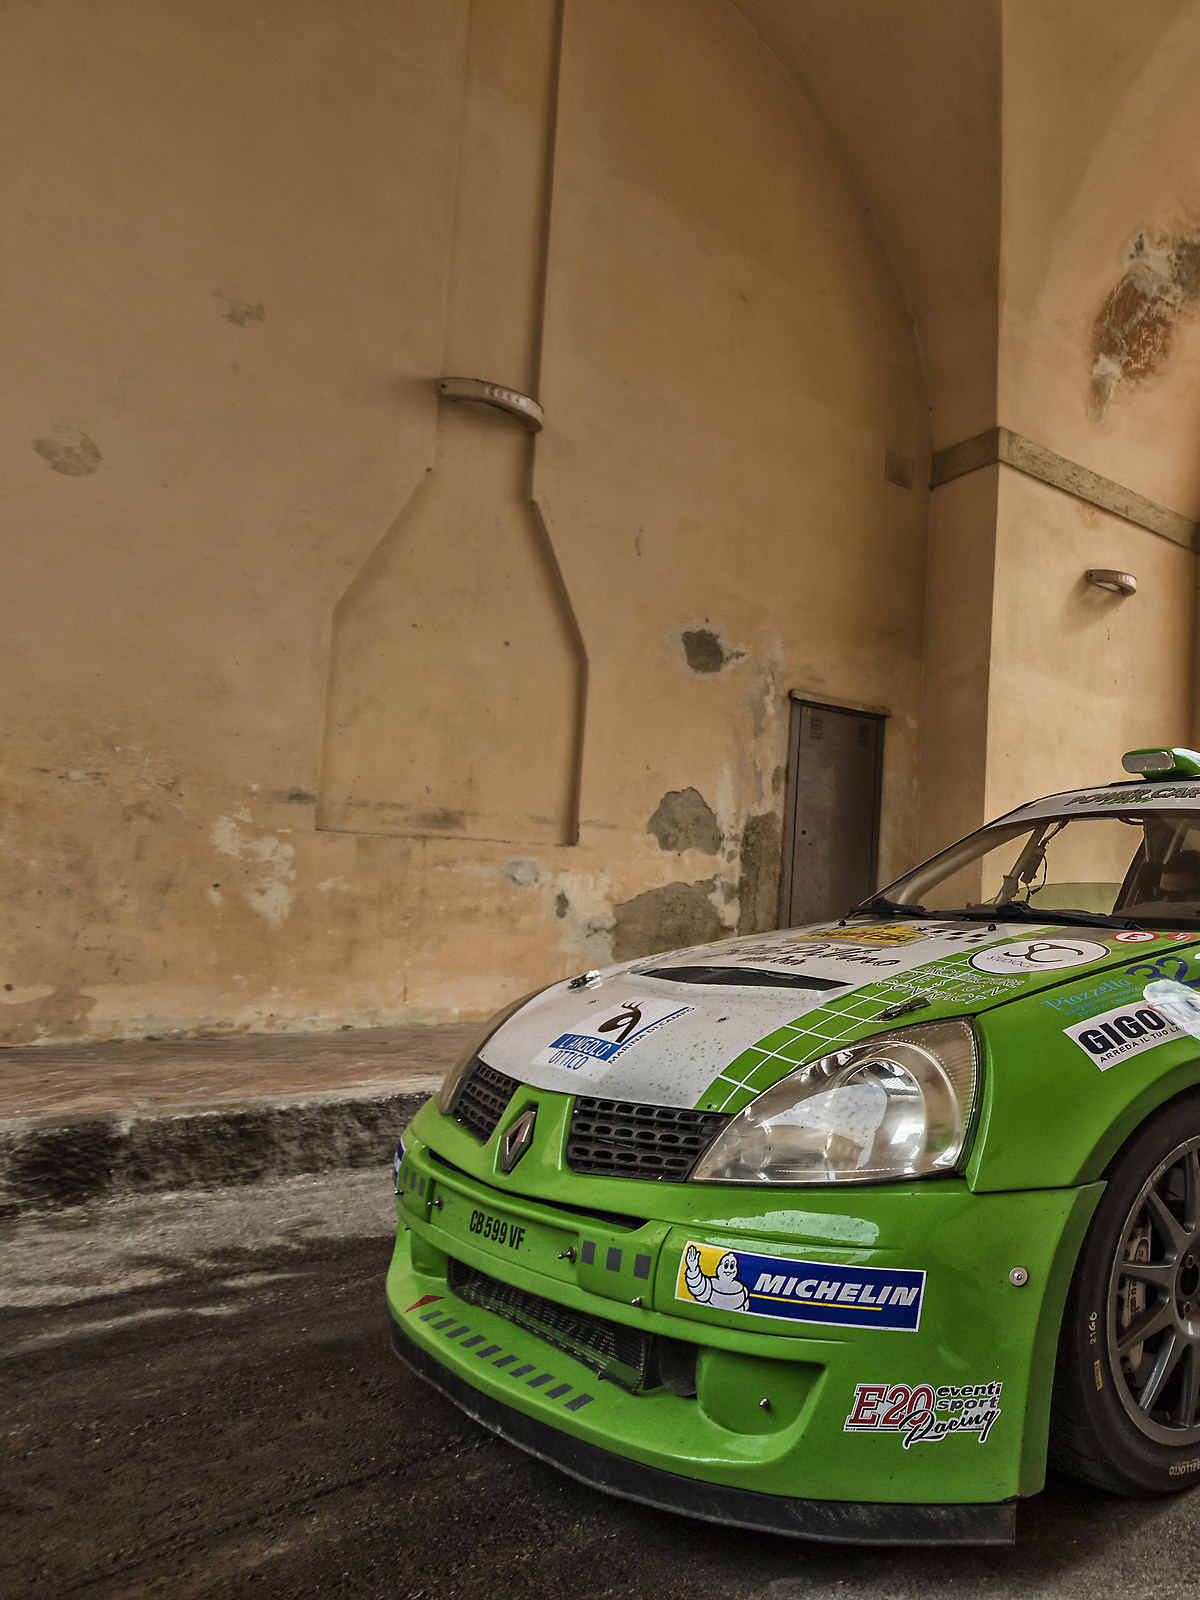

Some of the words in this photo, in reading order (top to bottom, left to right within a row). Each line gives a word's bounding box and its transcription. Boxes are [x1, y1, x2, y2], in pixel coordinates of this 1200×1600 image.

[1064, 788, 1151, 806] POWER
[877, 979, 987, 1005] CONTRACT
[896, 971, 1009, 997] DESIGN
[1042, 979, 1132, 1011] Piazzetta
[558, 1034, 611, 1057] L'ANGOLO
[607, 1034, 647, 1065] MARINA
[647, 1025, 659, 1035] DI
[658, 1007, 695, 1028] CAMPO
[1100, 1041, 1139, 1063] ARREDA
[1141, 1035, 1151, 1044] IL
[1151, 1030, 1169, 1040] TUO
[548, 1050, 590, 1071] OTTICO
[469, 1209, 486, 1235] CB
[483, 1216, 508, 1245] 599
[508, 1224, 526, 1250] VF
[753, 1273, 920, 1307] MICHELIN
[848, 1384, 936, 1428] E20
[937, 1383, 1003, 1398] eventi
[936, 1395, 999, 1412] sport
[898, 1408, 1001, 1448] Racing
[1168, 1460, 1200, 1476] BELLOTTO
